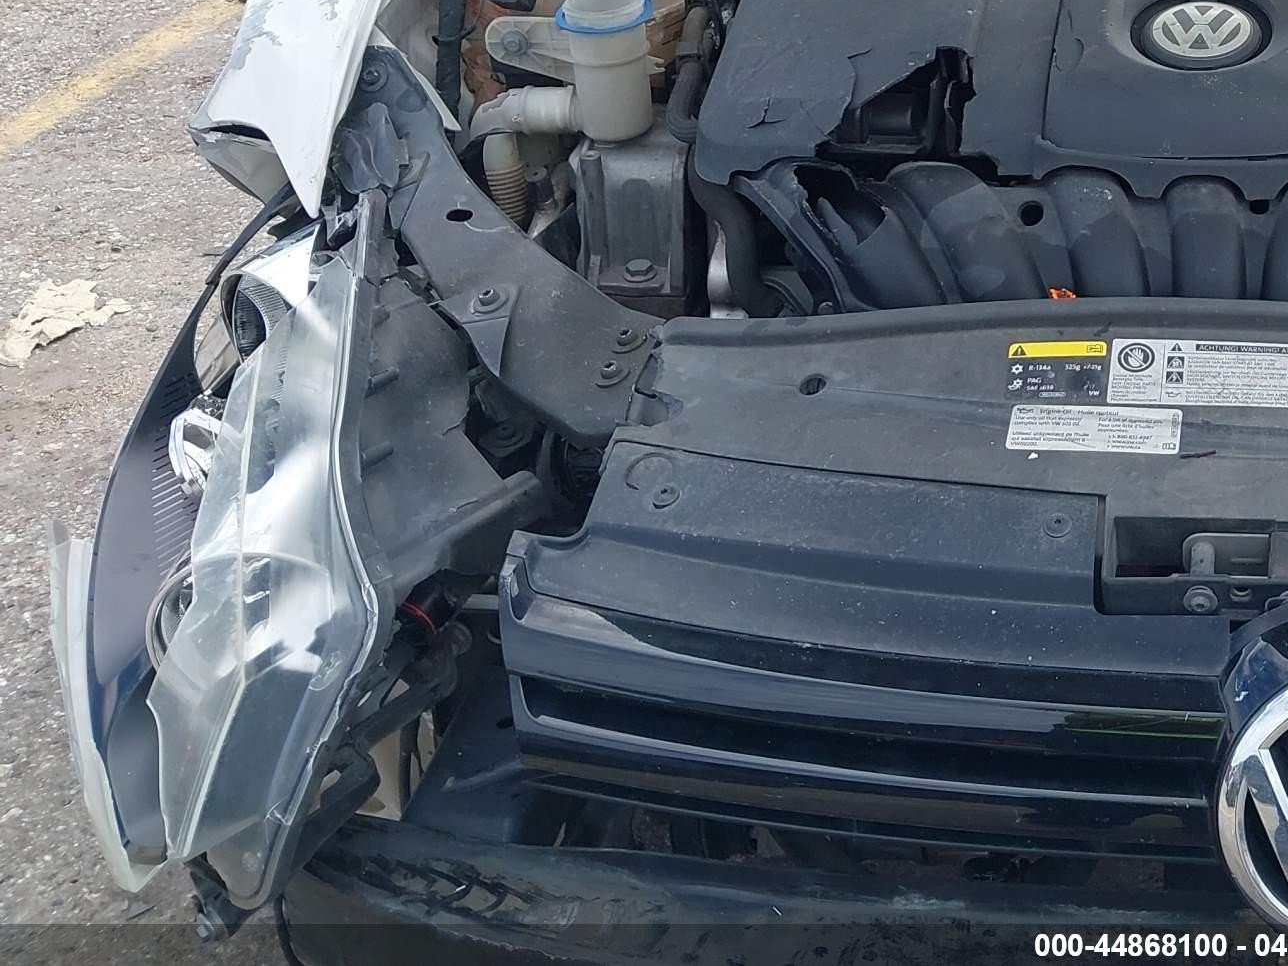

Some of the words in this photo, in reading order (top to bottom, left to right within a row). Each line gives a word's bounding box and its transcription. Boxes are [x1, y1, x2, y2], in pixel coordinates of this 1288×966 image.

[1152, 1, 1251, 58] VW
[1198, 344, 1239, 352] ACHTUNG!
[1240, 346, 1280, 354] WARNING!
